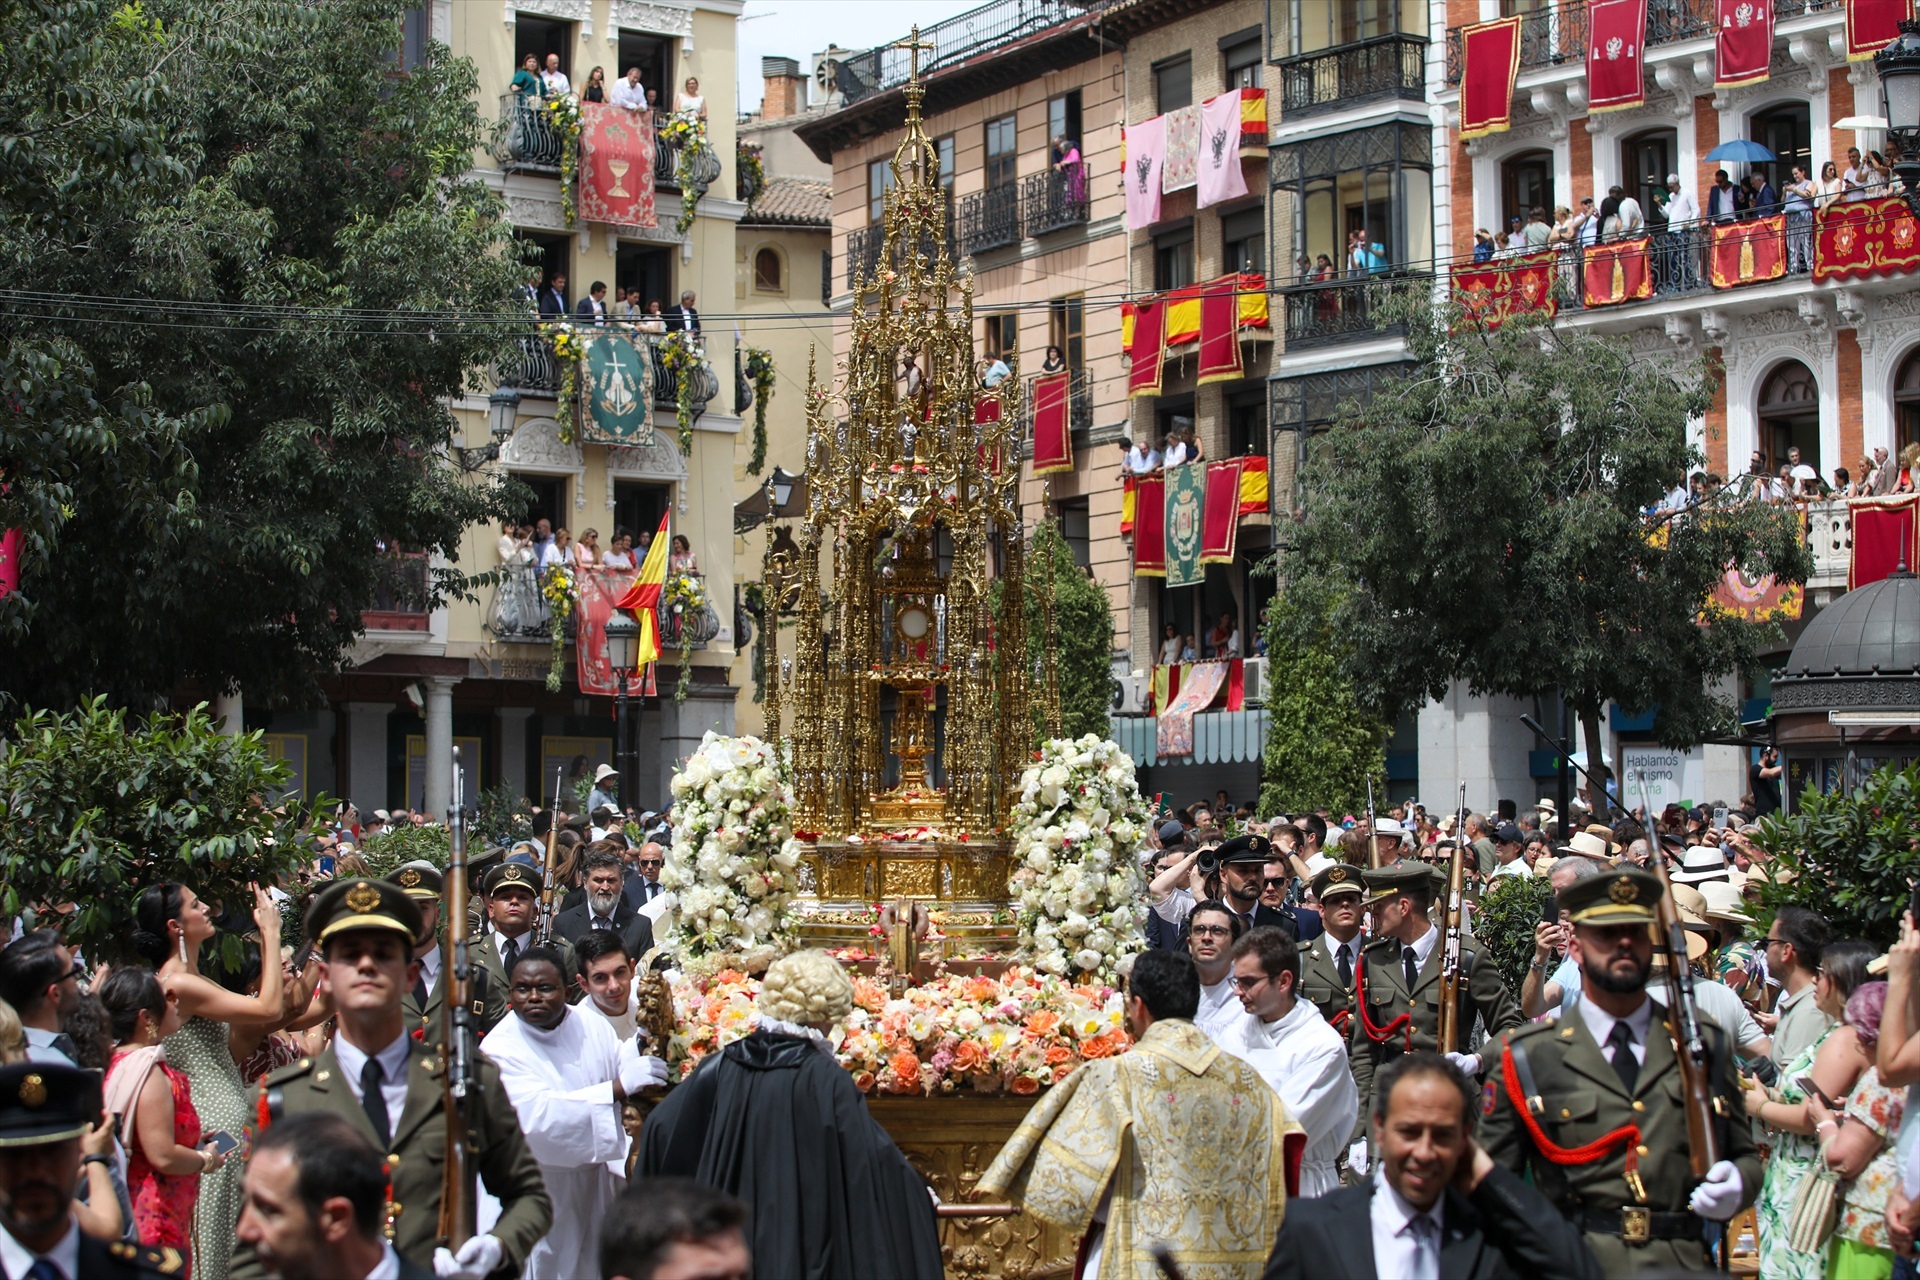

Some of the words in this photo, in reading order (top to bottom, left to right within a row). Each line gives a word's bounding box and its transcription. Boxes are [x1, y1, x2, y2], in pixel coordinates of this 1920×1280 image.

[502, 667, 537, 678] RURAL
[1627, 755, 1679, 767] Hablamos
[1627, 769, 1636, 781] el
[1627, 783, 1662, 795] idima
